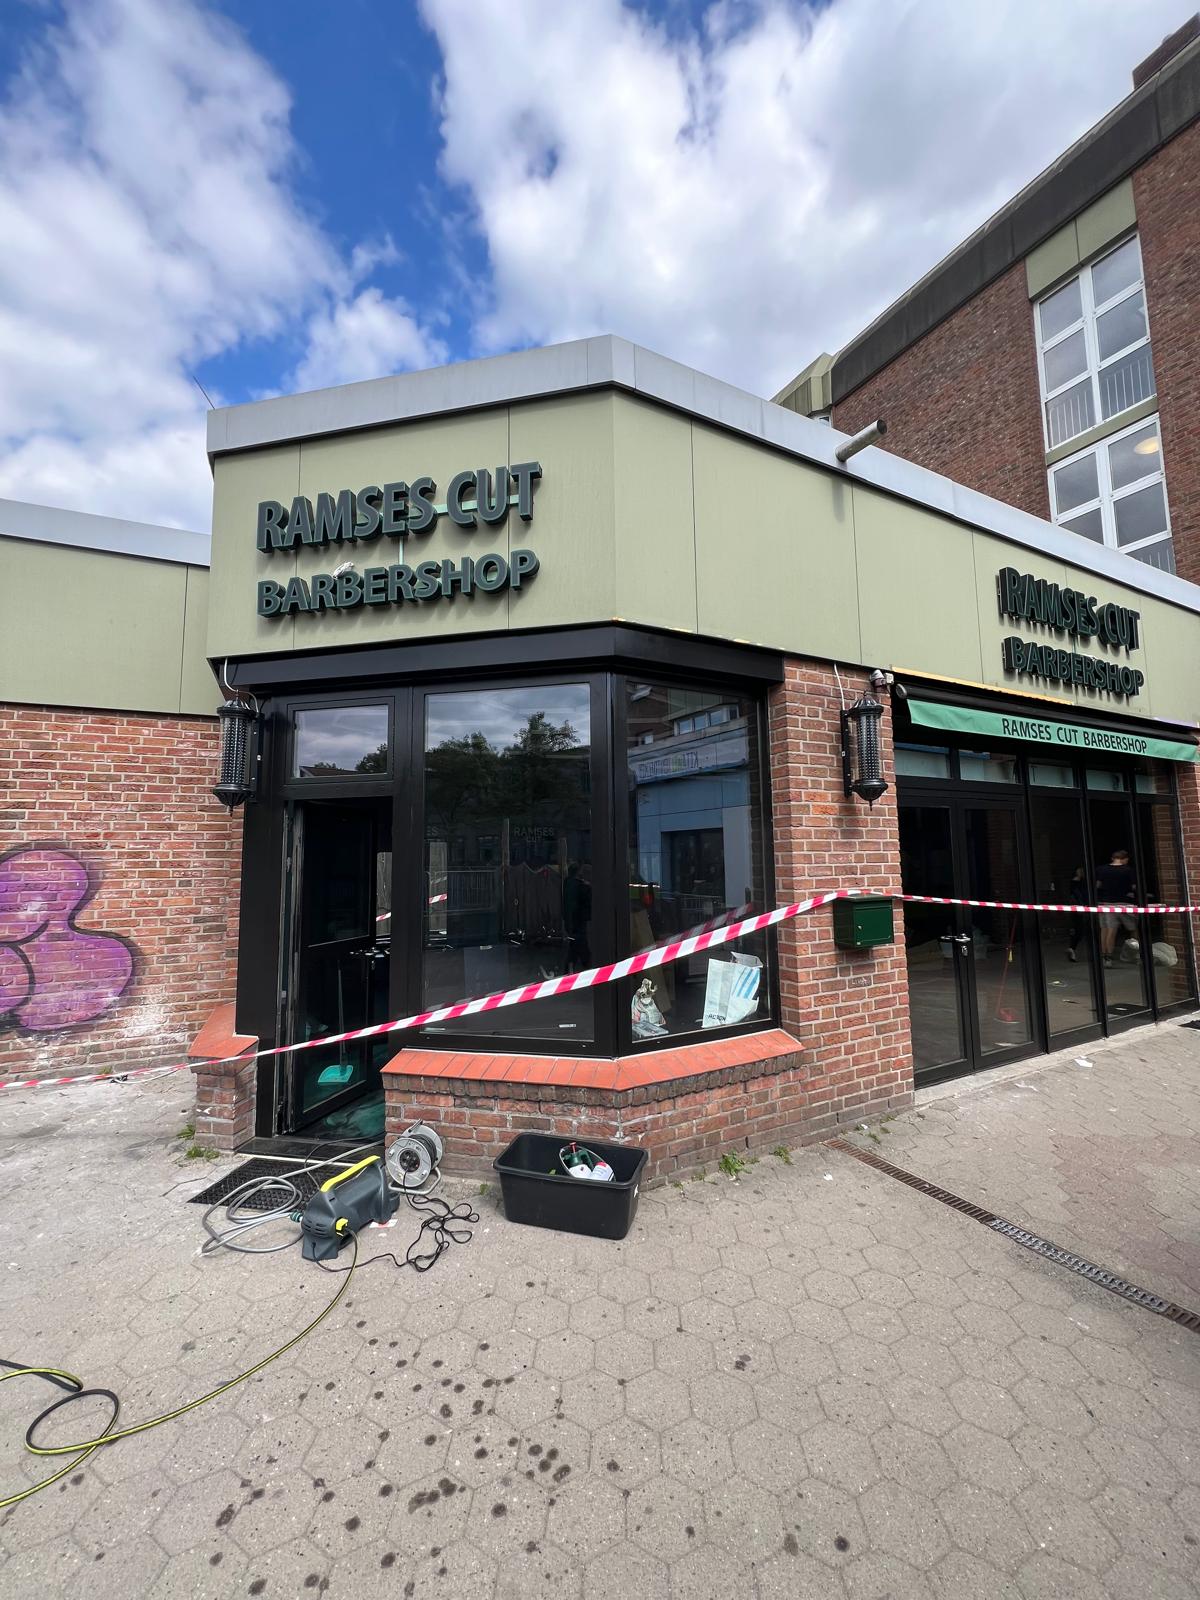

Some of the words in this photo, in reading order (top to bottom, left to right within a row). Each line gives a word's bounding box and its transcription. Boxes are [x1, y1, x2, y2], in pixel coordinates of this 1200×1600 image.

[257, 477, 437, 553] RAMSES
[447, 461, 543, 528] CUT
[257, 549, 540, 618] BARBERSHOP
[999, 567, 1100, 636] RAMSES
[1097, 602, 1141, 651] CUT
[1004, 636, 1144, 696] BARBERSHOP
[1002, 718, 1052, 741] RAMSES
[1057, 727, 1078, 745] CUT
[1084, 733, 1147, 754] BARBERSHOP
